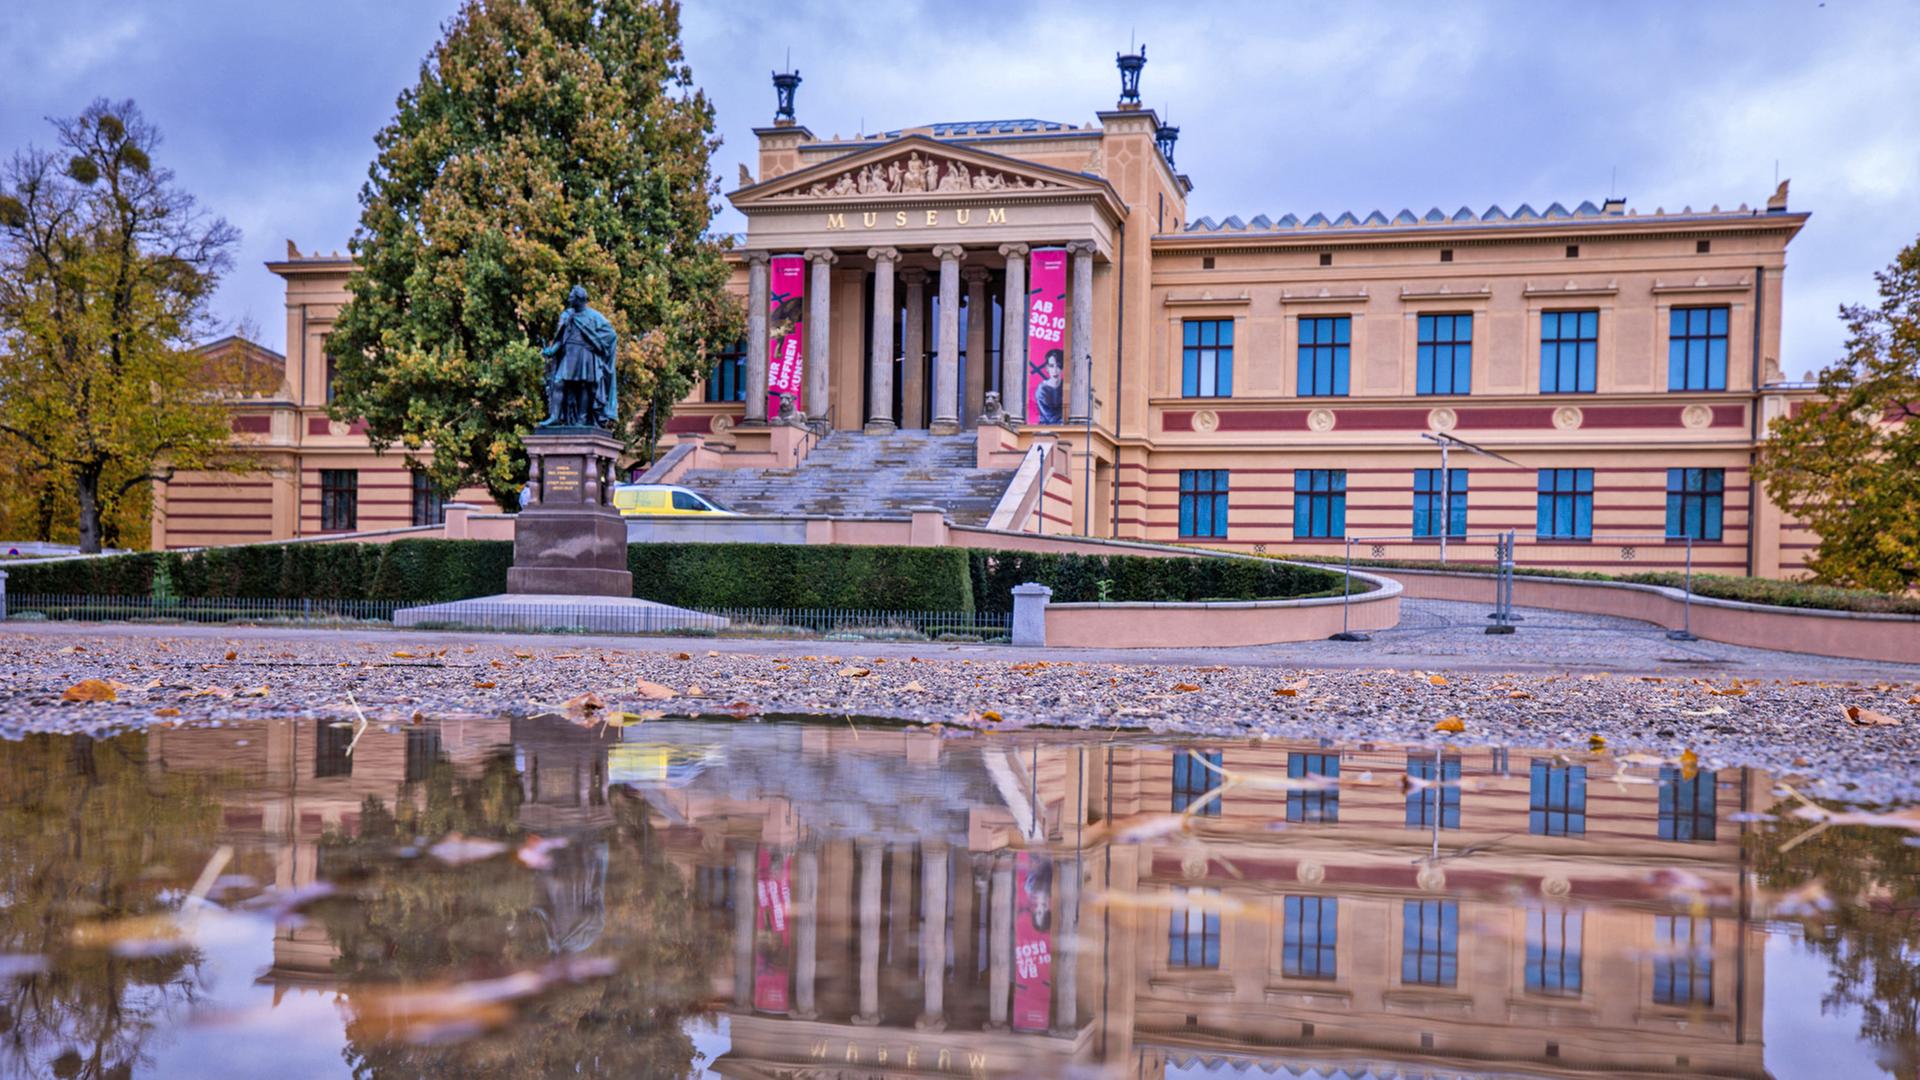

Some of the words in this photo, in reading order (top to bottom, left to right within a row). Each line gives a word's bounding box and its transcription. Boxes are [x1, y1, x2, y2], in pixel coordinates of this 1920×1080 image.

[826, 207, 1007, 230] MUSEUM
[1032, 300, 1053, 313] AB
[1029, 325, 1061, 342] 2025
[768, 362, 780, 386] WIR
[777, 339, 797, 389] ÖFFNEN
